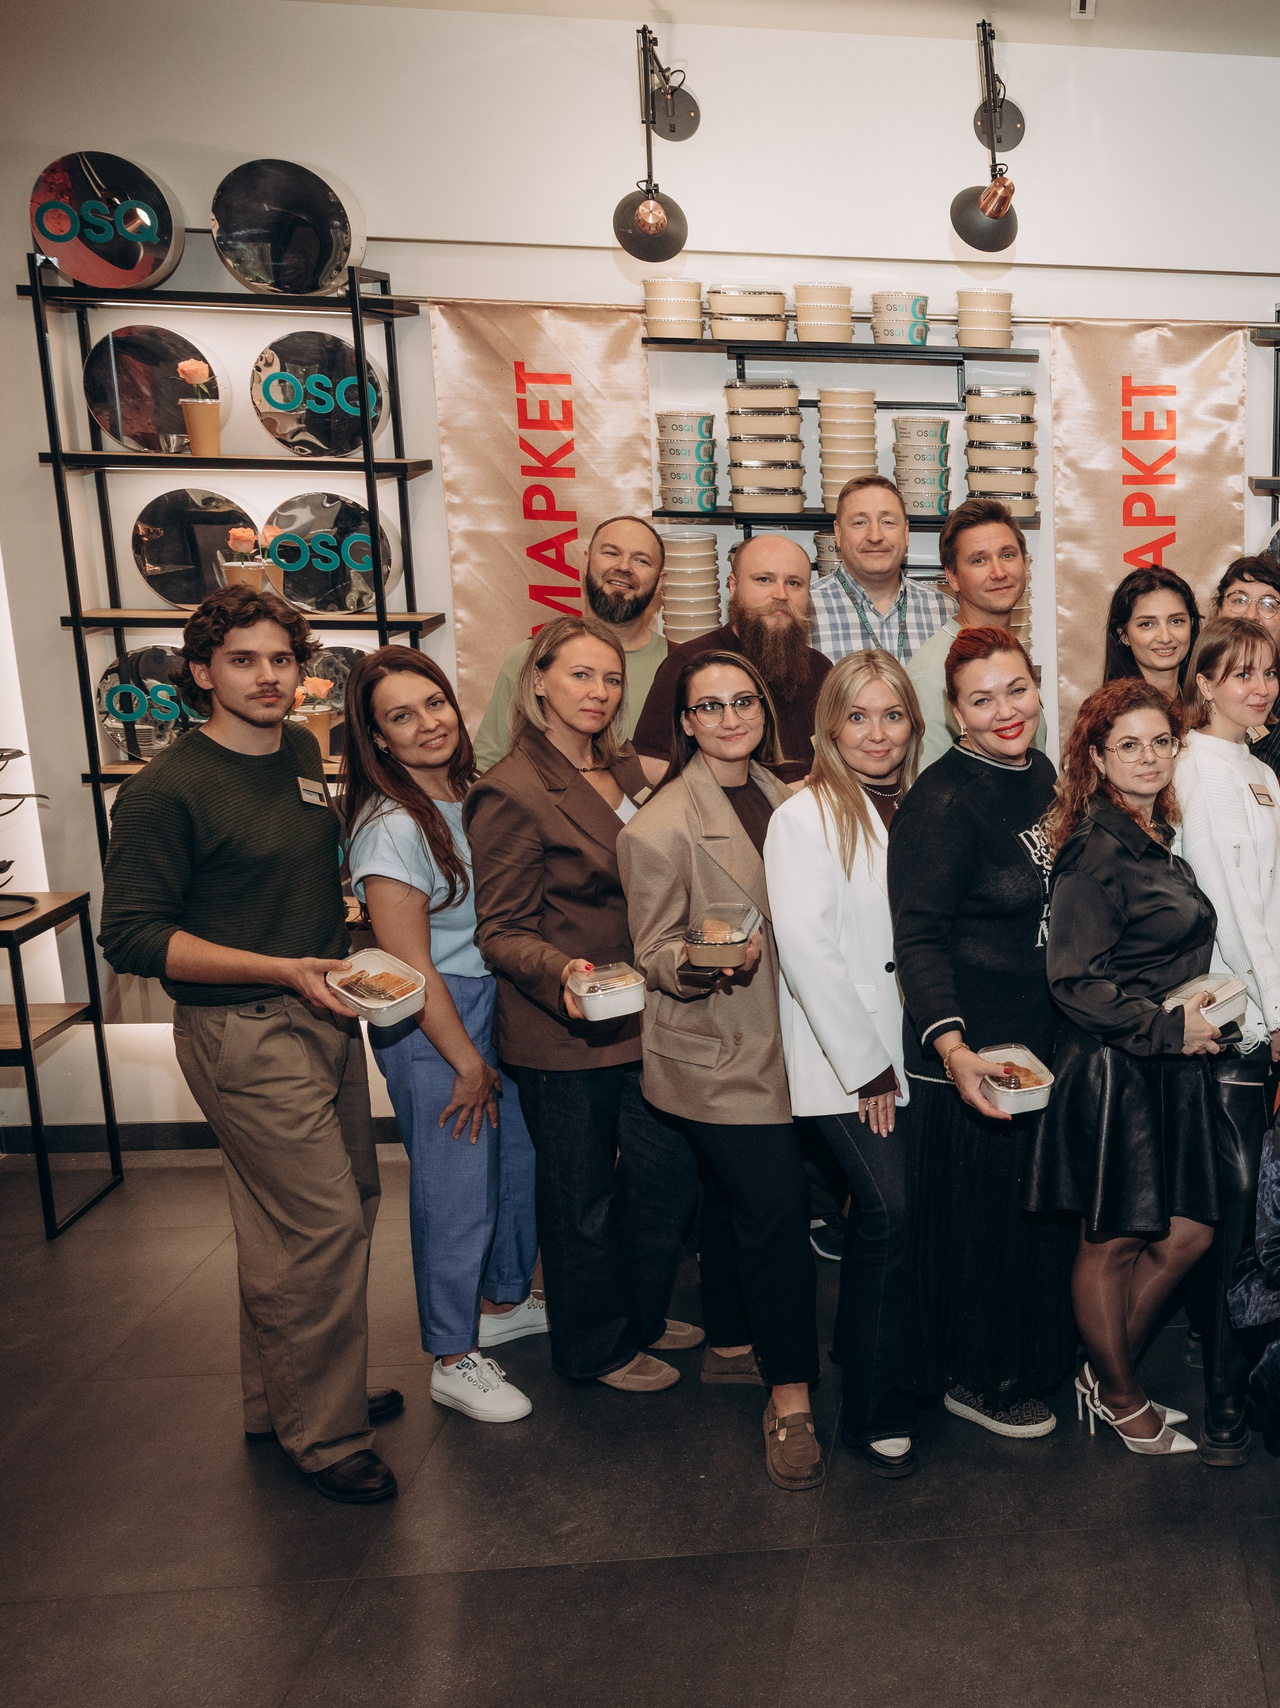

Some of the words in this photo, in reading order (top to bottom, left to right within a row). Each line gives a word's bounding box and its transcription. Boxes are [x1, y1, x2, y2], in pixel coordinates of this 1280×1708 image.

[34, 200, 160, 245] OSQ
[886, 304, 904, 312] OSQ
[883, 328, 901, 336] OSQ
[262, 372, 376, 418] OSQ
[669, 448, 688, 456] OSQ
[670, 472, 688, 480] OSQ
[672, 496, 690, 504] OSQ
[269, 533, 374, 572] OSQ
